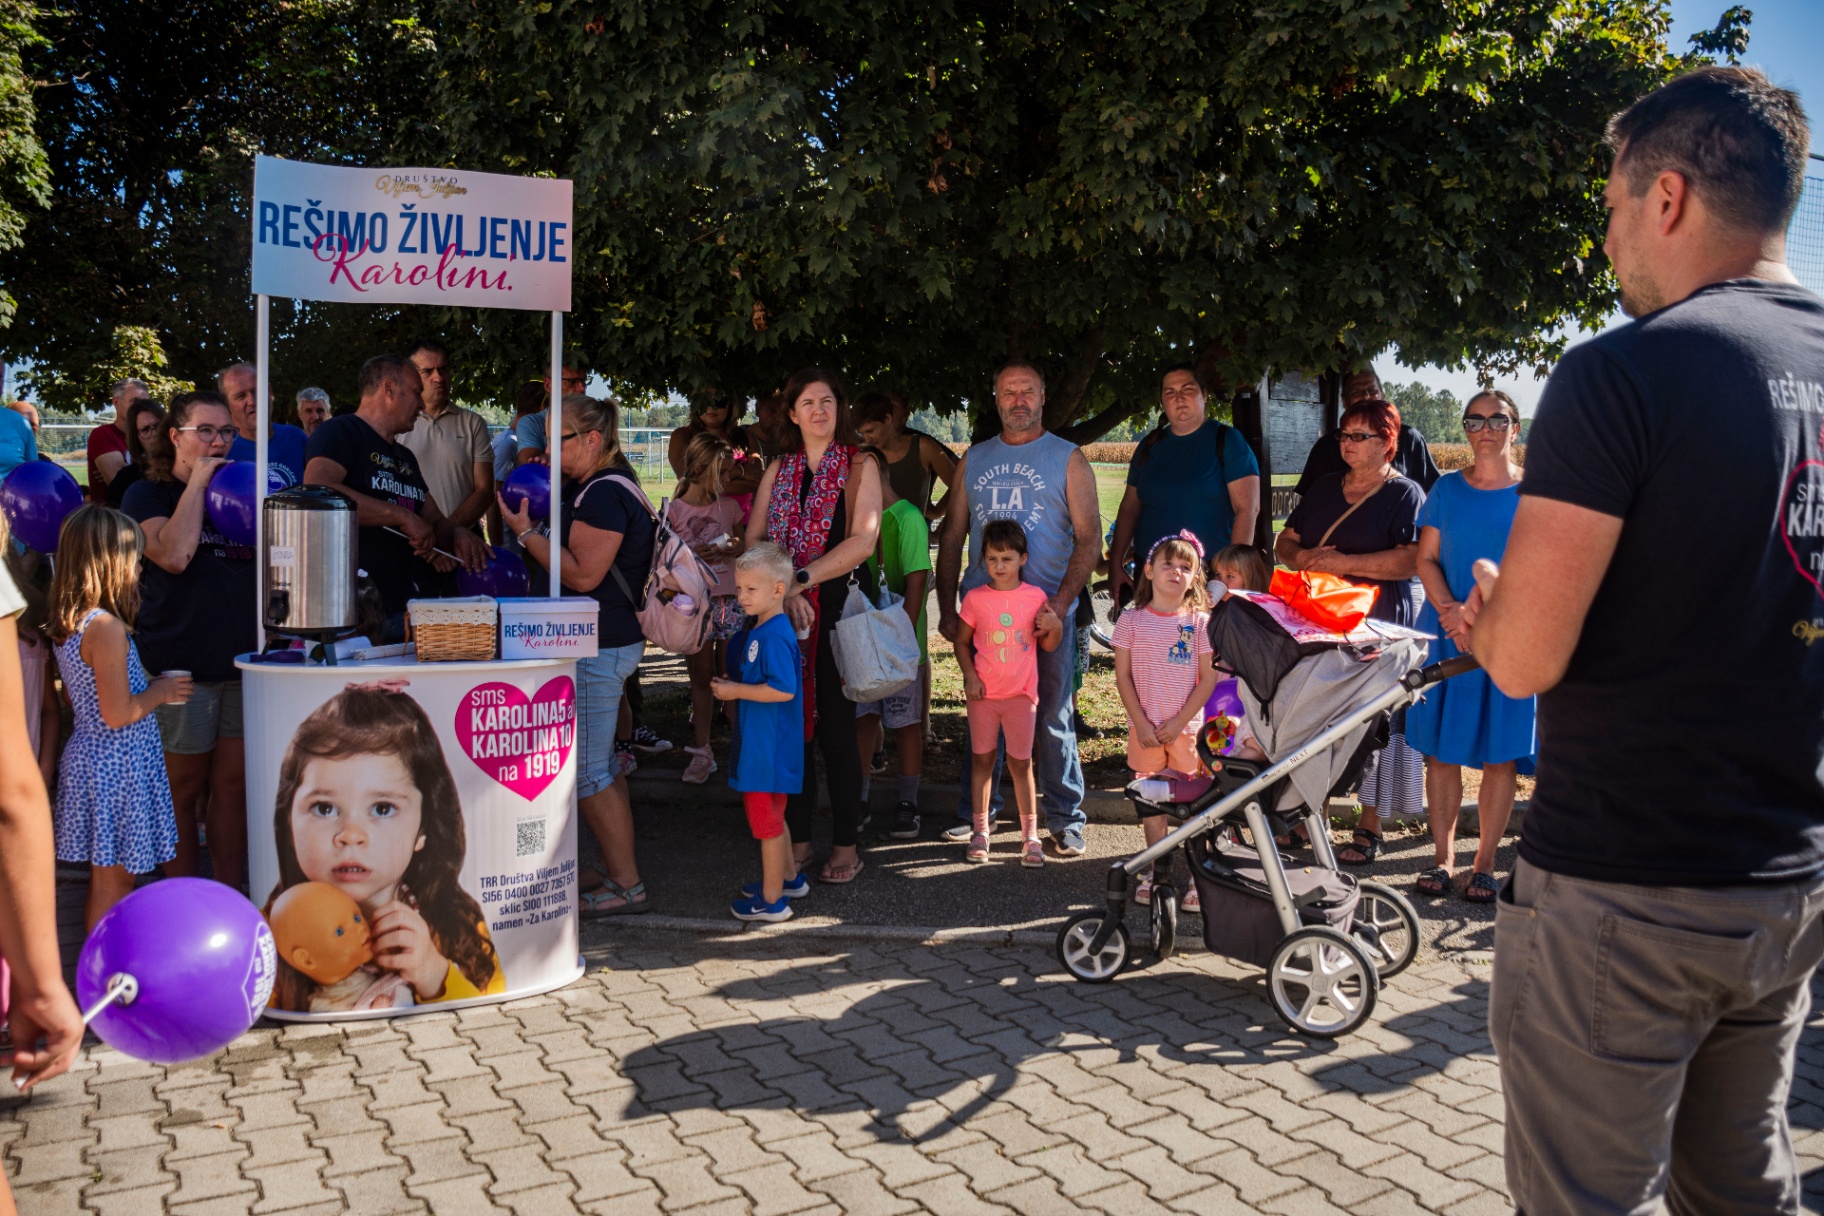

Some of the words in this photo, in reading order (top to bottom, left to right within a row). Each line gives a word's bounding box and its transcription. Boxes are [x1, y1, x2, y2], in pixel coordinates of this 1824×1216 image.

[394, 174, 458, 184] DRUŠTVO
[258, 199, 388, 254] REŠIMO
[397, 203, 567, 263] ŽIVLJENJE
[312, 232, 513, 292] Karolini.
[1767, 370, 1824, 413] REŠIMO
[973, 463, 1009, 492] SOUTH
[1013, 462, 1046, 491] BEACH
[993, 511, 1018, 521] 1994
[504, 622, 543, 638] REŠIMO
[545, 621, 596, 637] ŽIVLJENJE
[471, 689, 506, 706] sms
[471, 698, 566, 733] KAROLINA5
[472, 723, 572, 759] KAROLINA10
[499, 764, 518, 781] na
[524, 751, 560, 779] 1919
[480, 876, 498, 889] TRR
[500, 872, 534, 886] Društva
[537, 866, 559, 880] Viljem
[482, 890, 503, 903] SI56
[505, 886, 528, 900] 0400
[530, 882, 549, 896] 0027
[499, 902, 522, 916] sklic
[523, 898, 542, 911] SI00
[492, 917, 524, 932] namen
